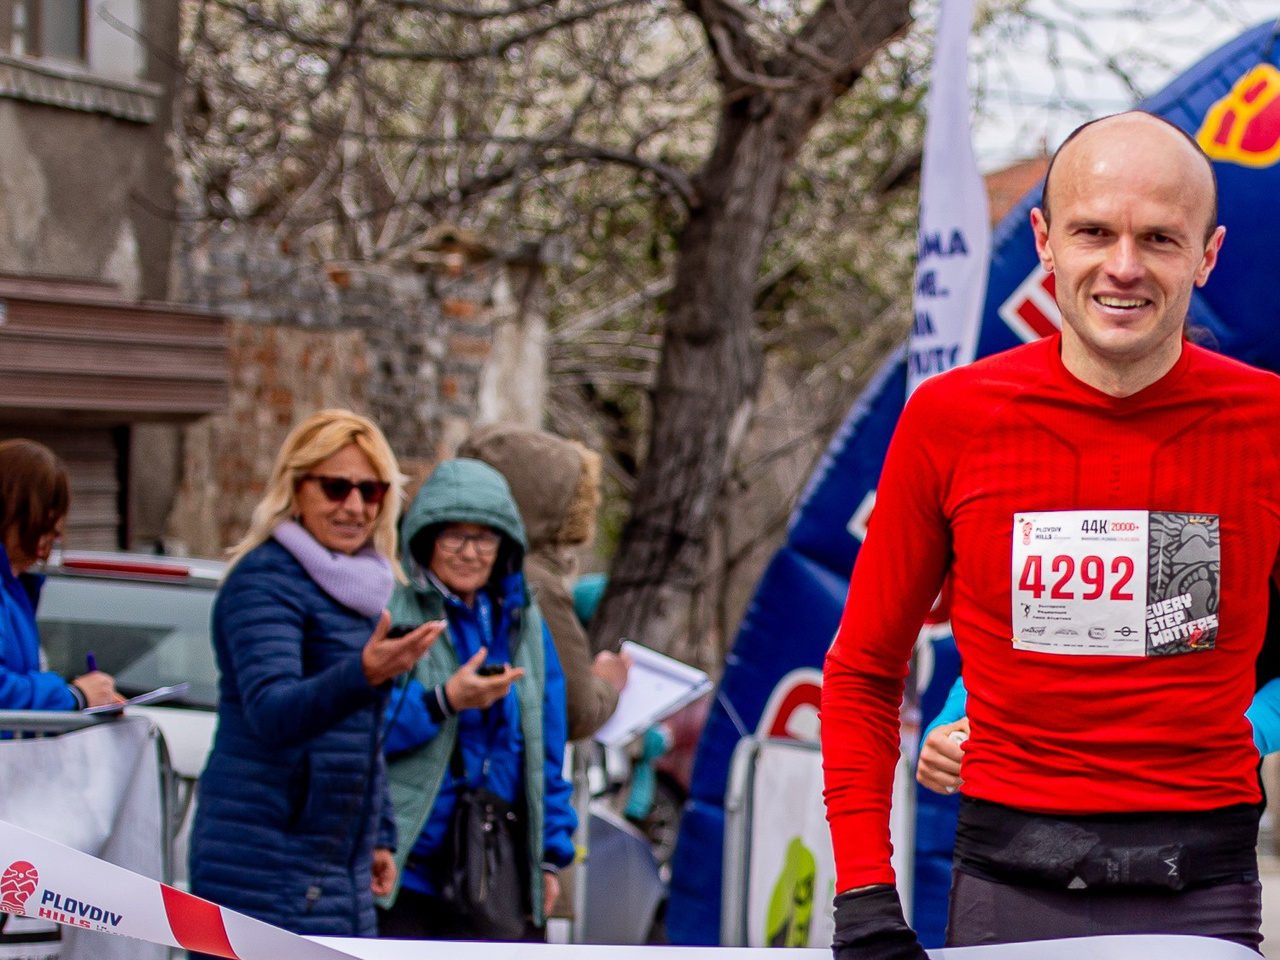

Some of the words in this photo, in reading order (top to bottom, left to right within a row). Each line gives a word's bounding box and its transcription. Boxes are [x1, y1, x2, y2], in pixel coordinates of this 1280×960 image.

[1081, 519, 1108, 534] 44K
[1018, 555, 1135, 601] 4292
[1146, 593, 1193, 619] EVERY
[1146, 610, 1186, 633] STEP
[1149, 614, 1219, 647] MATTERS
[38, 907, 91, 929] HILLS
[41, 888, 123, 927] PLOVDIV
